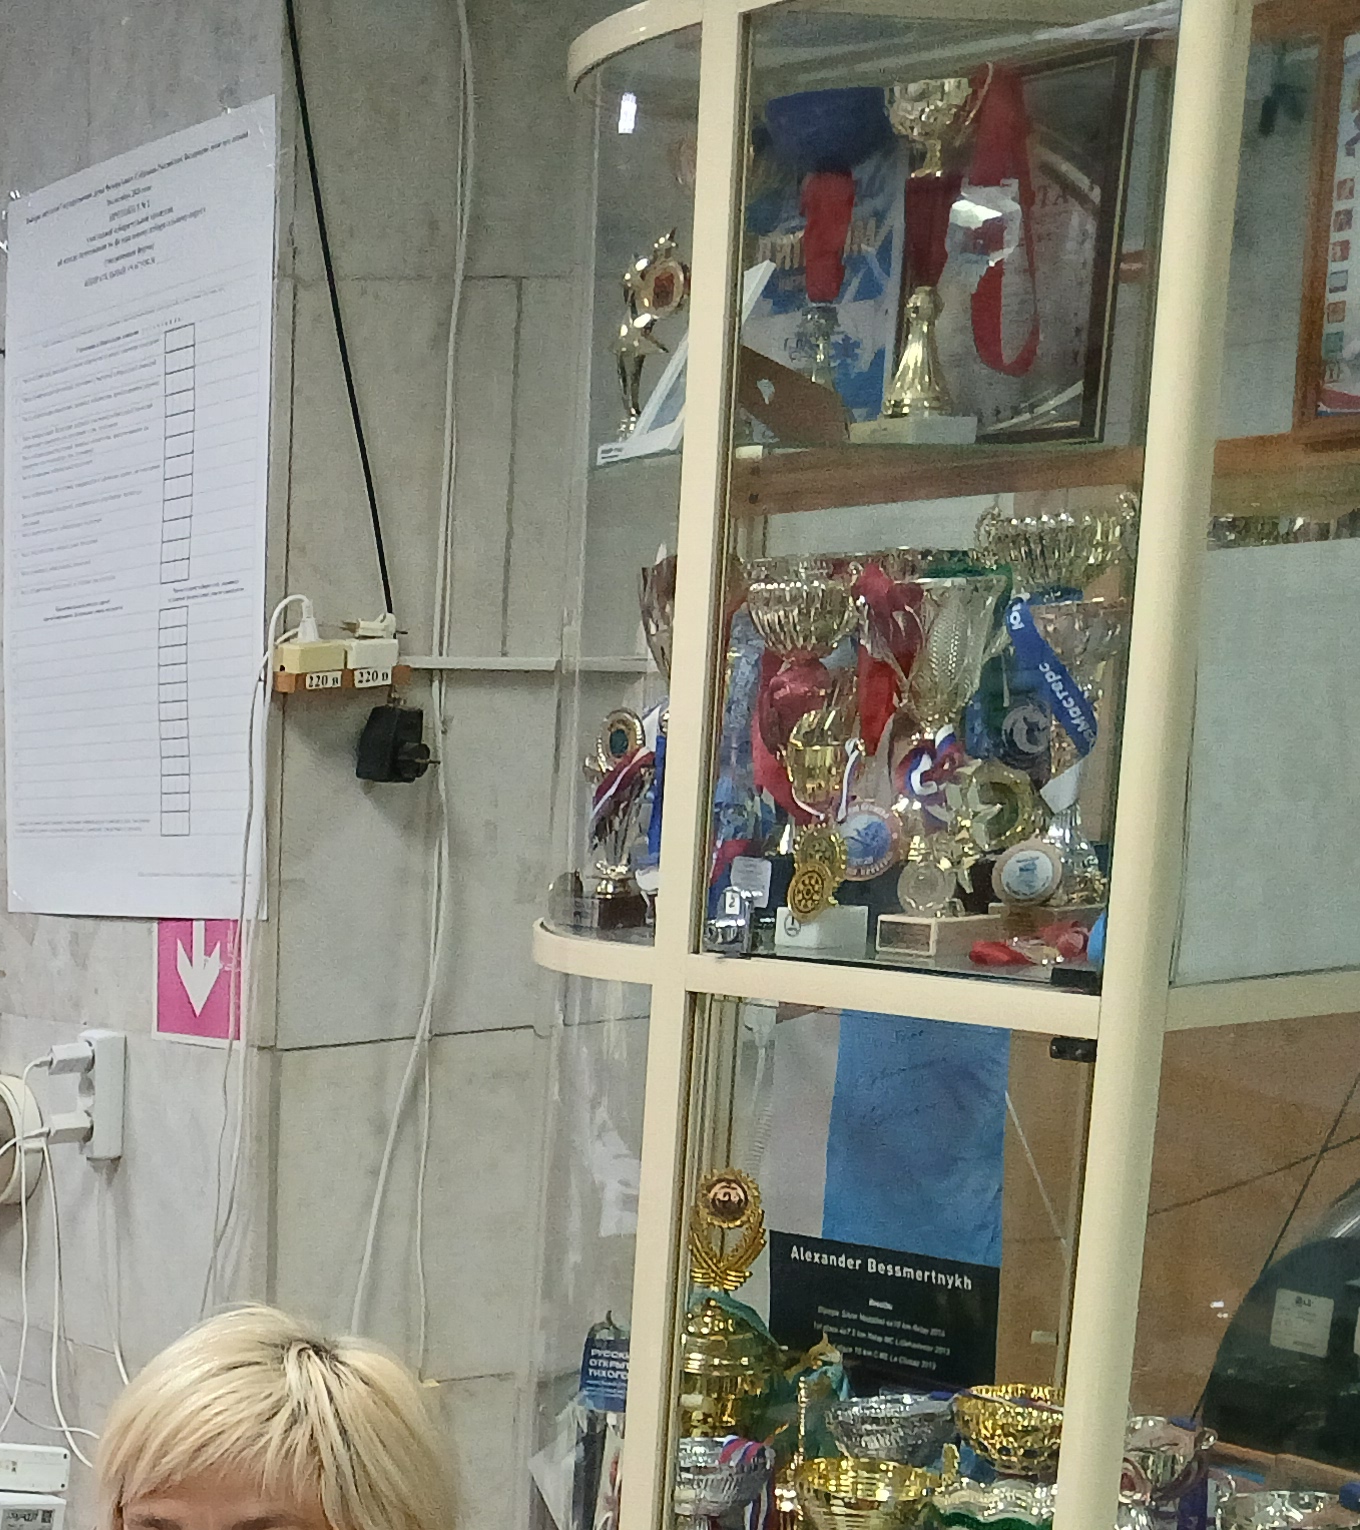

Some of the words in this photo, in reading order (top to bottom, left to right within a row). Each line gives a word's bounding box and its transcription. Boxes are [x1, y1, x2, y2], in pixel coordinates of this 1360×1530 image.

[308, 674, 328, 687] 220
[358, 671, 378, 683] 220
[791, 1244, 862, 1271] Alexander
[868, 1258, 973, 1291] Bessmertnykh
